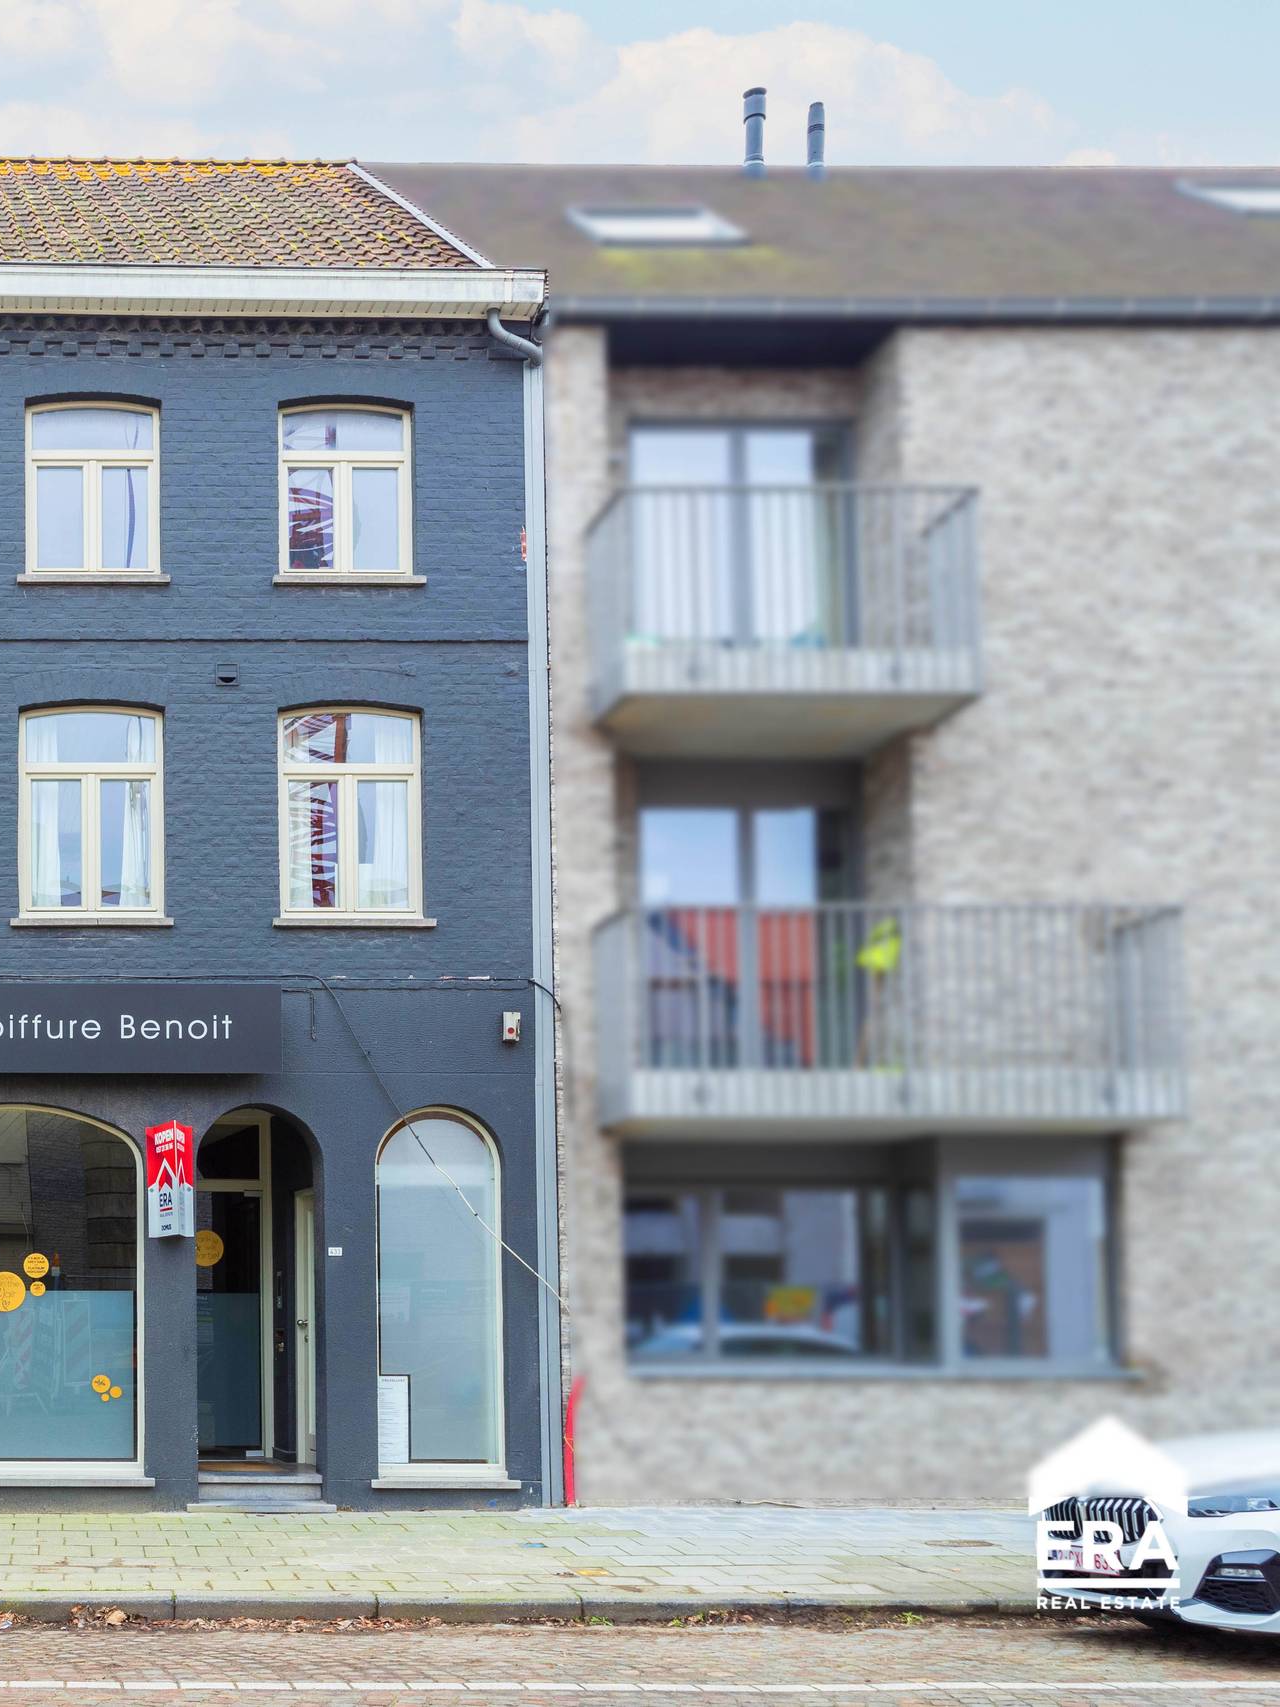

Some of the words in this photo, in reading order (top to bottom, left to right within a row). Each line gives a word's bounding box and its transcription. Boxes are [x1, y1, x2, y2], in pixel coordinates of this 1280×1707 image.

[120, 1014, 233, 1040] Benoit
[154, 1128, 174, 1146] KOPEN
[159, 1191, 173, 1207] ERA
